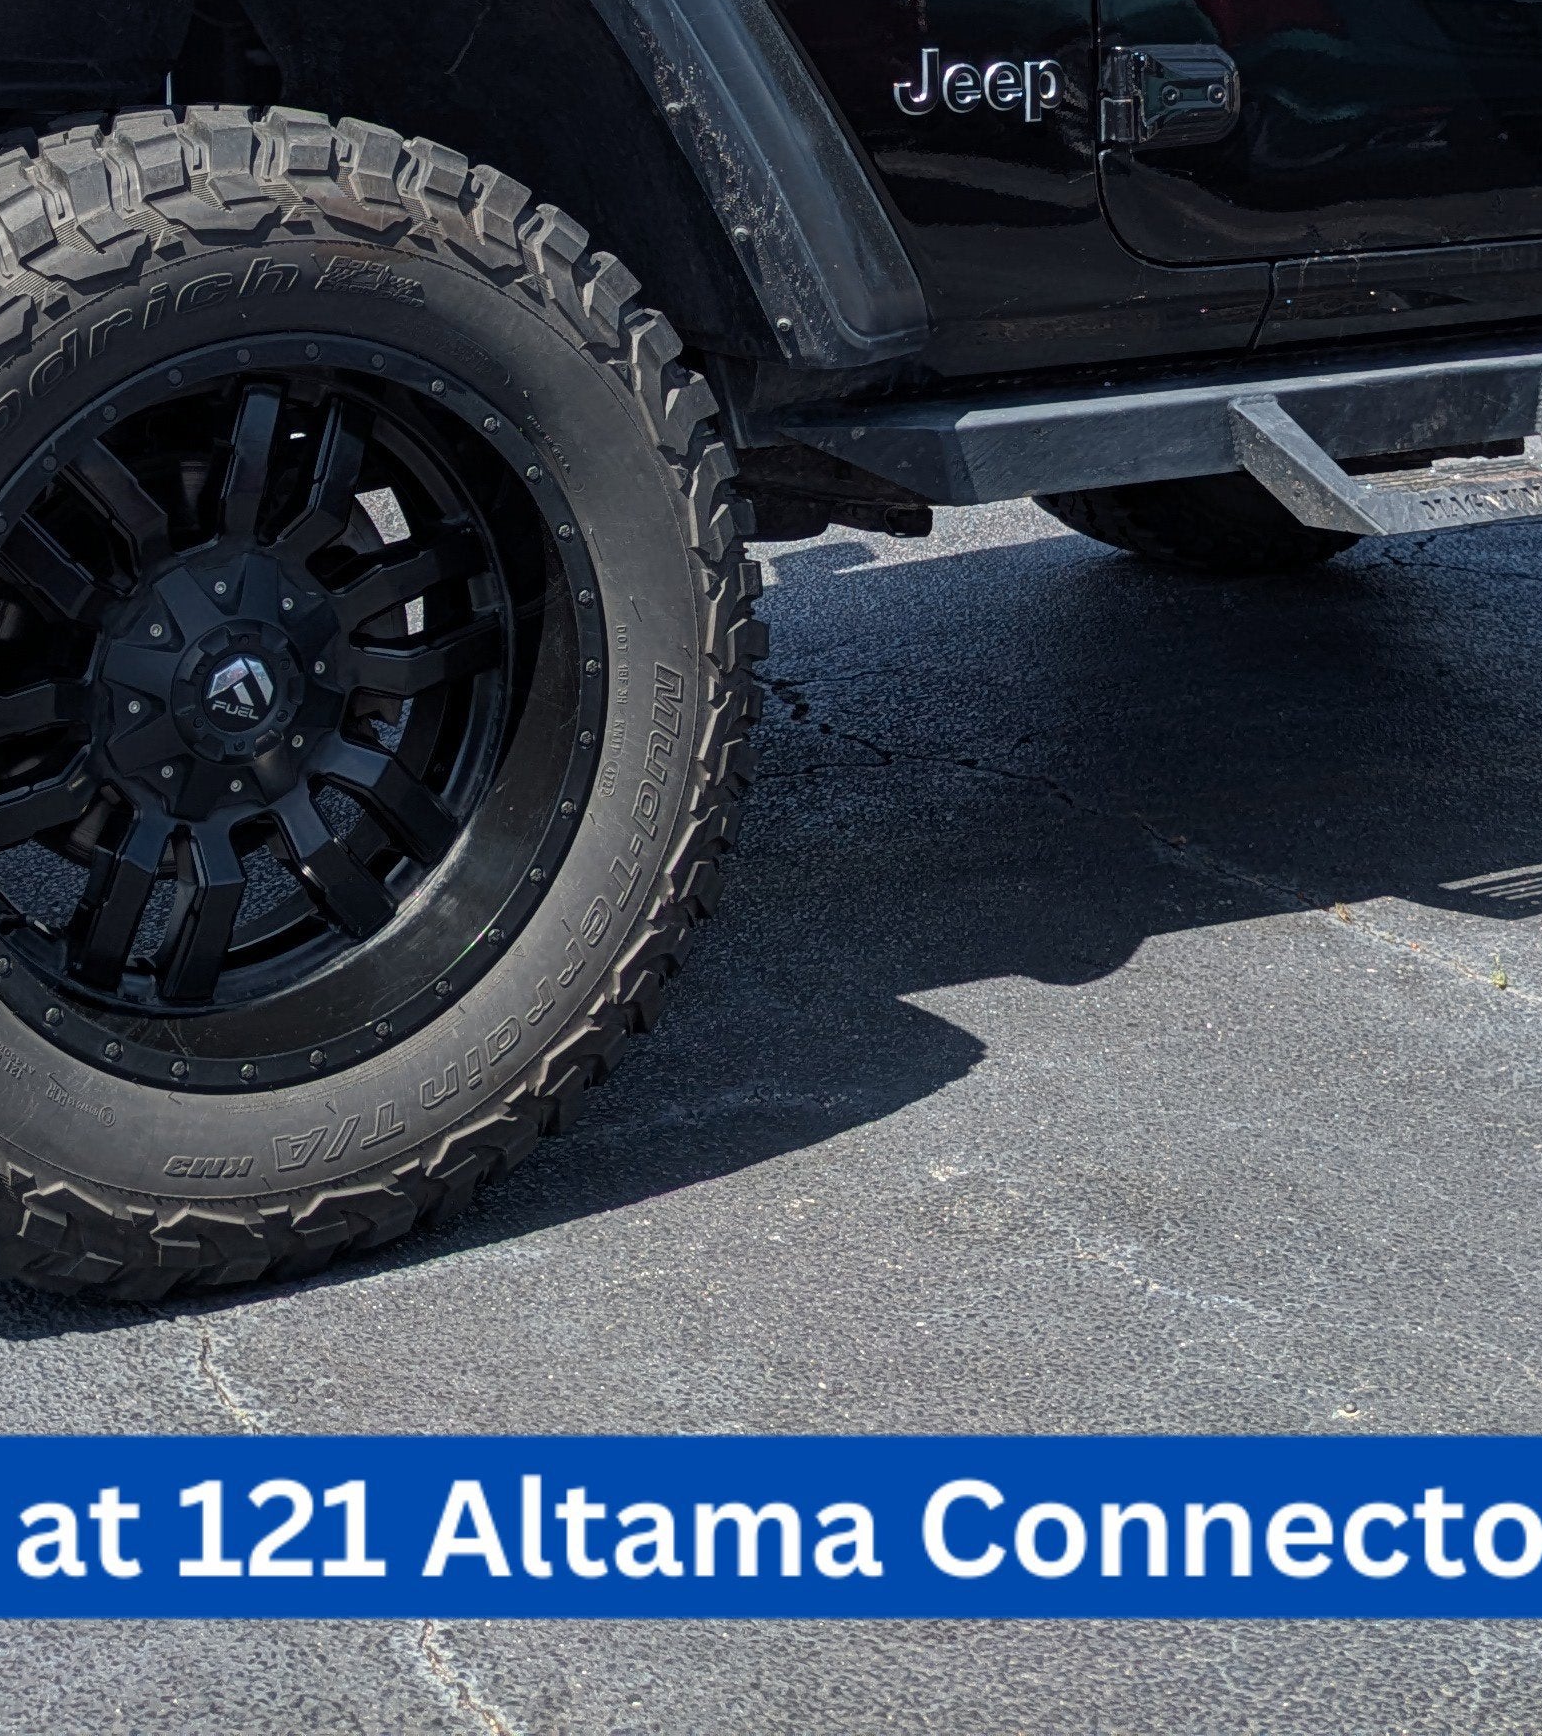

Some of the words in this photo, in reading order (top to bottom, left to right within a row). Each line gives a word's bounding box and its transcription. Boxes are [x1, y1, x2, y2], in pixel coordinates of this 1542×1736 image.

[893, 47, 1063, 123] Jeep
[211, 700, 259, 720] FUEL
[420, 662, 685, 1110] Mud-Terrain
[164, 1154, 253, 1179] KM3
[272, 1101, 405, 1173] T/A
